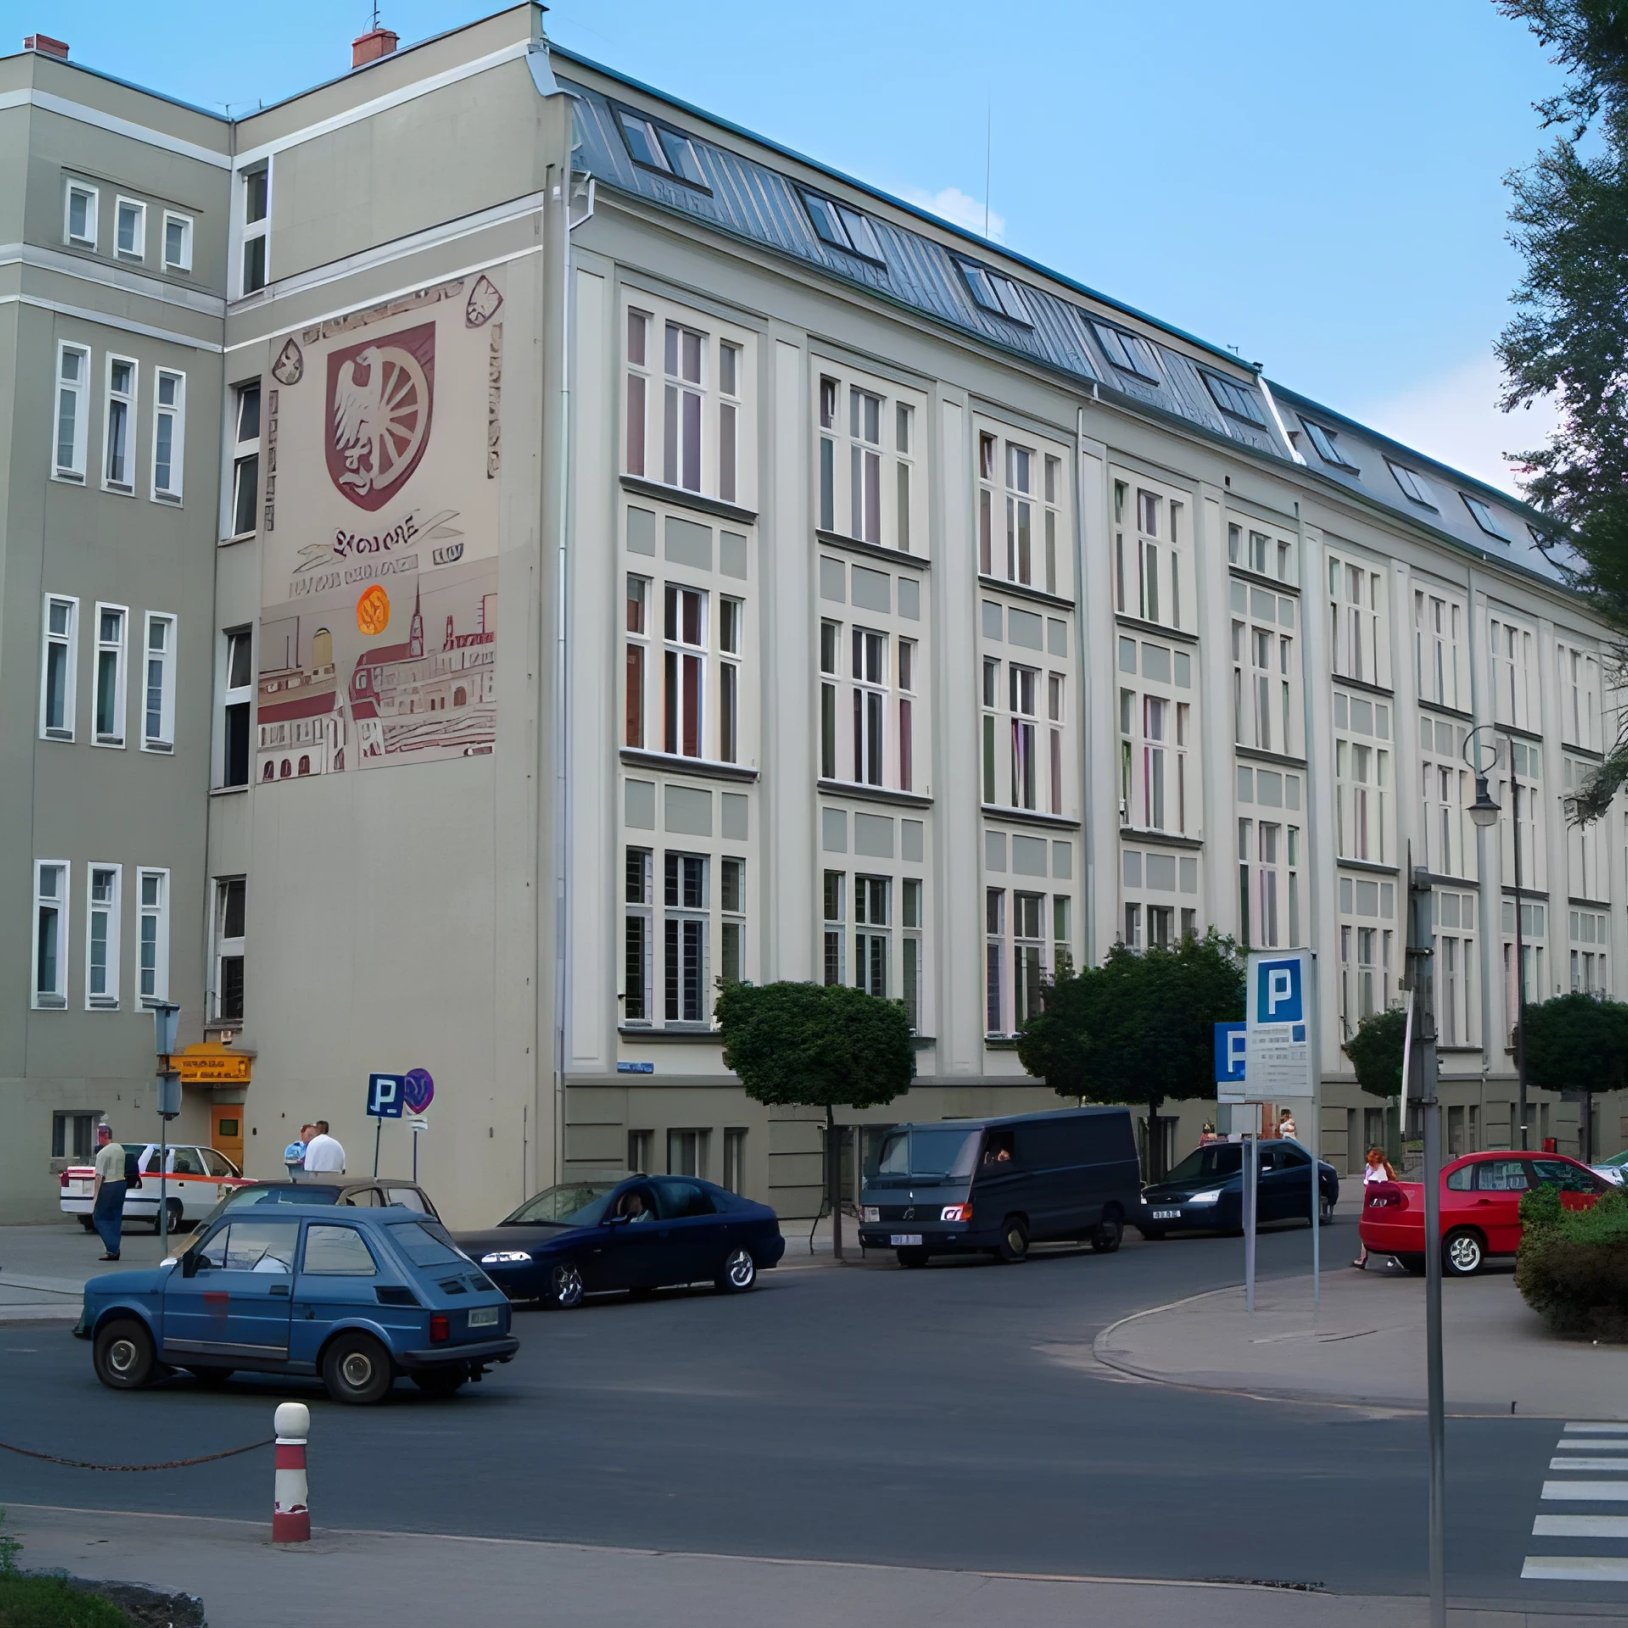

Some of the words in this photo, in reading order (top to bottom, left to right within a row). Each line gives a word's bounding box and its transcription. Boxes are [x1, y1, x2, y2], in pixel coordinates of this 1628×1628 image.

[1268, 969, 1291, 1014] P
[1227, 1031, 1246, 1072] P
[370, 1078, 396, 1112] P
